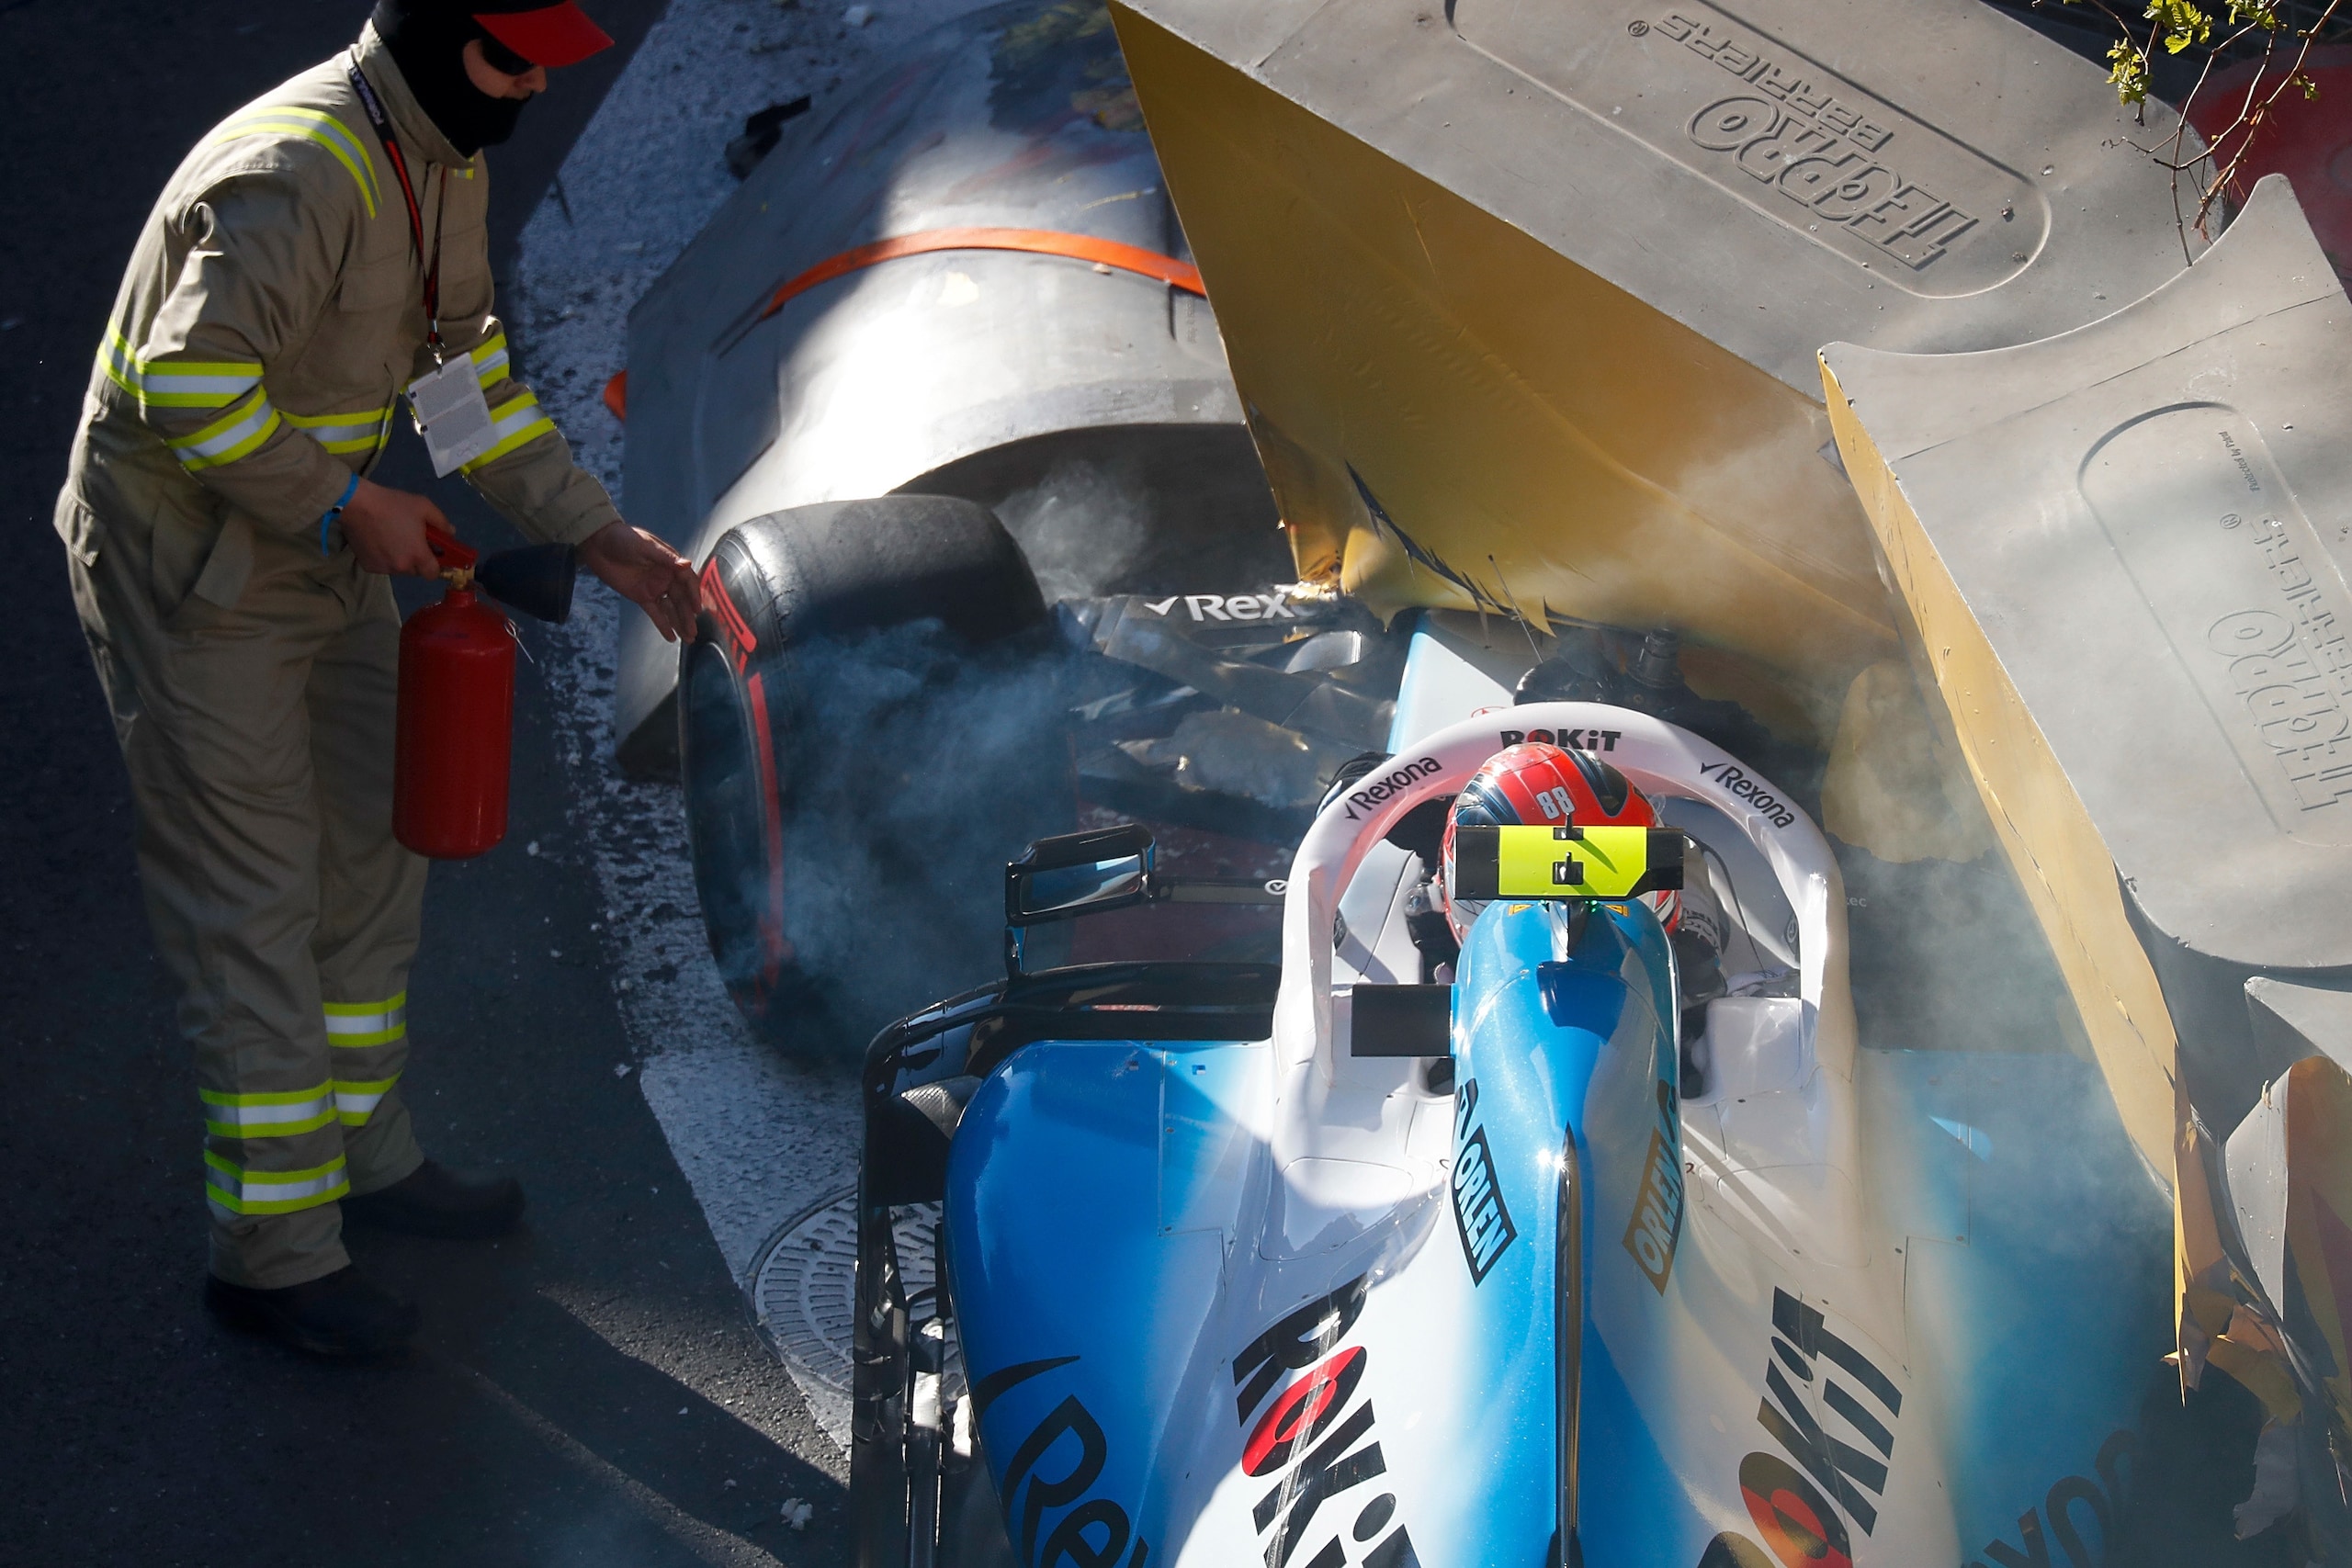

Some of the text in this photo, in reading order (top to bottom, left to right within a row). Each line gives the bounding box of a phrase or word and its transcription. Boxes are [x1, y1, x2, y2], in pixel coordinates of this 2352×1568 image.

[1685, 94, 1980, 272] TECPRO
[1355, 756, 1442, 813] Rexona
[1536, 786, 1577, 820] 88
[1719, 765, 1795, 829] Rexona
[1454, 1143, 1509, 1273] ORLEN
[1634, 1143, 1683, 1275] ORLEN
